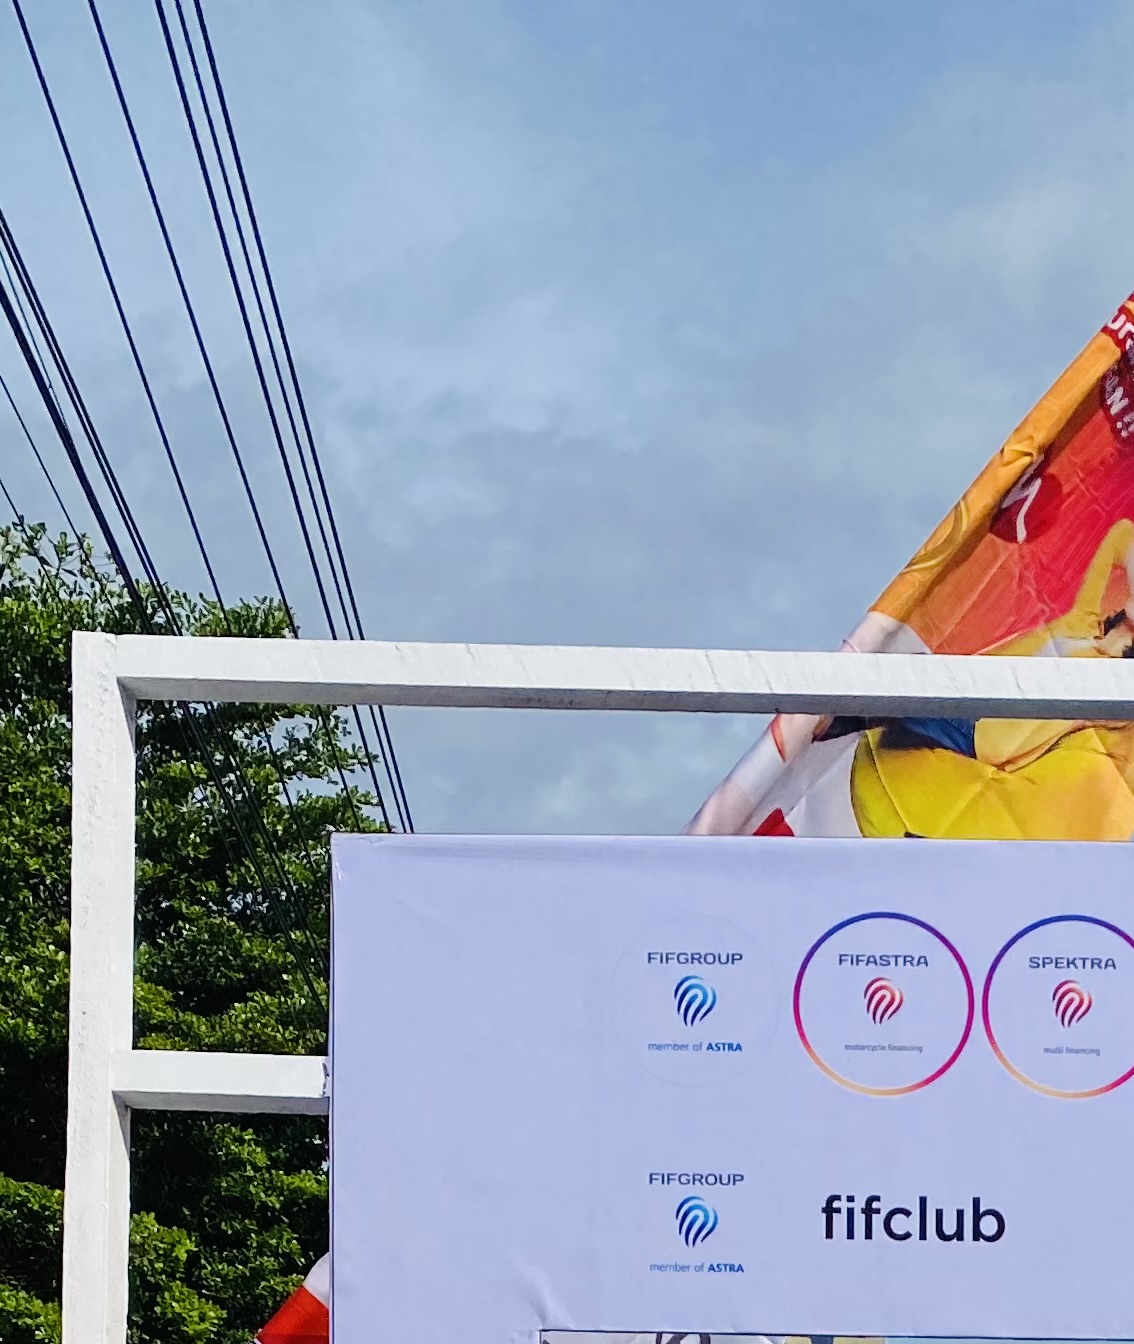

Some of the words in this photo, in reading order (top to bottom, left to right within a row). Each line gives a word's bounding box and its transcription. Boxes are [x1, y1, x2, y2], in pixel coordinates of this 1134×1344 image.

[647, 951, 743, 965] FIFGROUP
[838, 953, 929, 968] FIFASTRA
[1028, 955, 1117, 970] SPEKTRA
[648, 1042, 689, 1051] member
[692, 1042, 703, 1051] of
[706, 1042, 743, 1052] ASTRA
[887, 1044, 923, 1054] financing
[1065, 1046, 1100, 1057] financing
[648, 1172, 745, 1186] FIFGROUP
[821, 1194, 1006, 1244] fifclub
[649, 1262, 689, 1273] member
[693, 1261, 704, 1273] of
[707, 1262, 745, 1273] ASTRA
